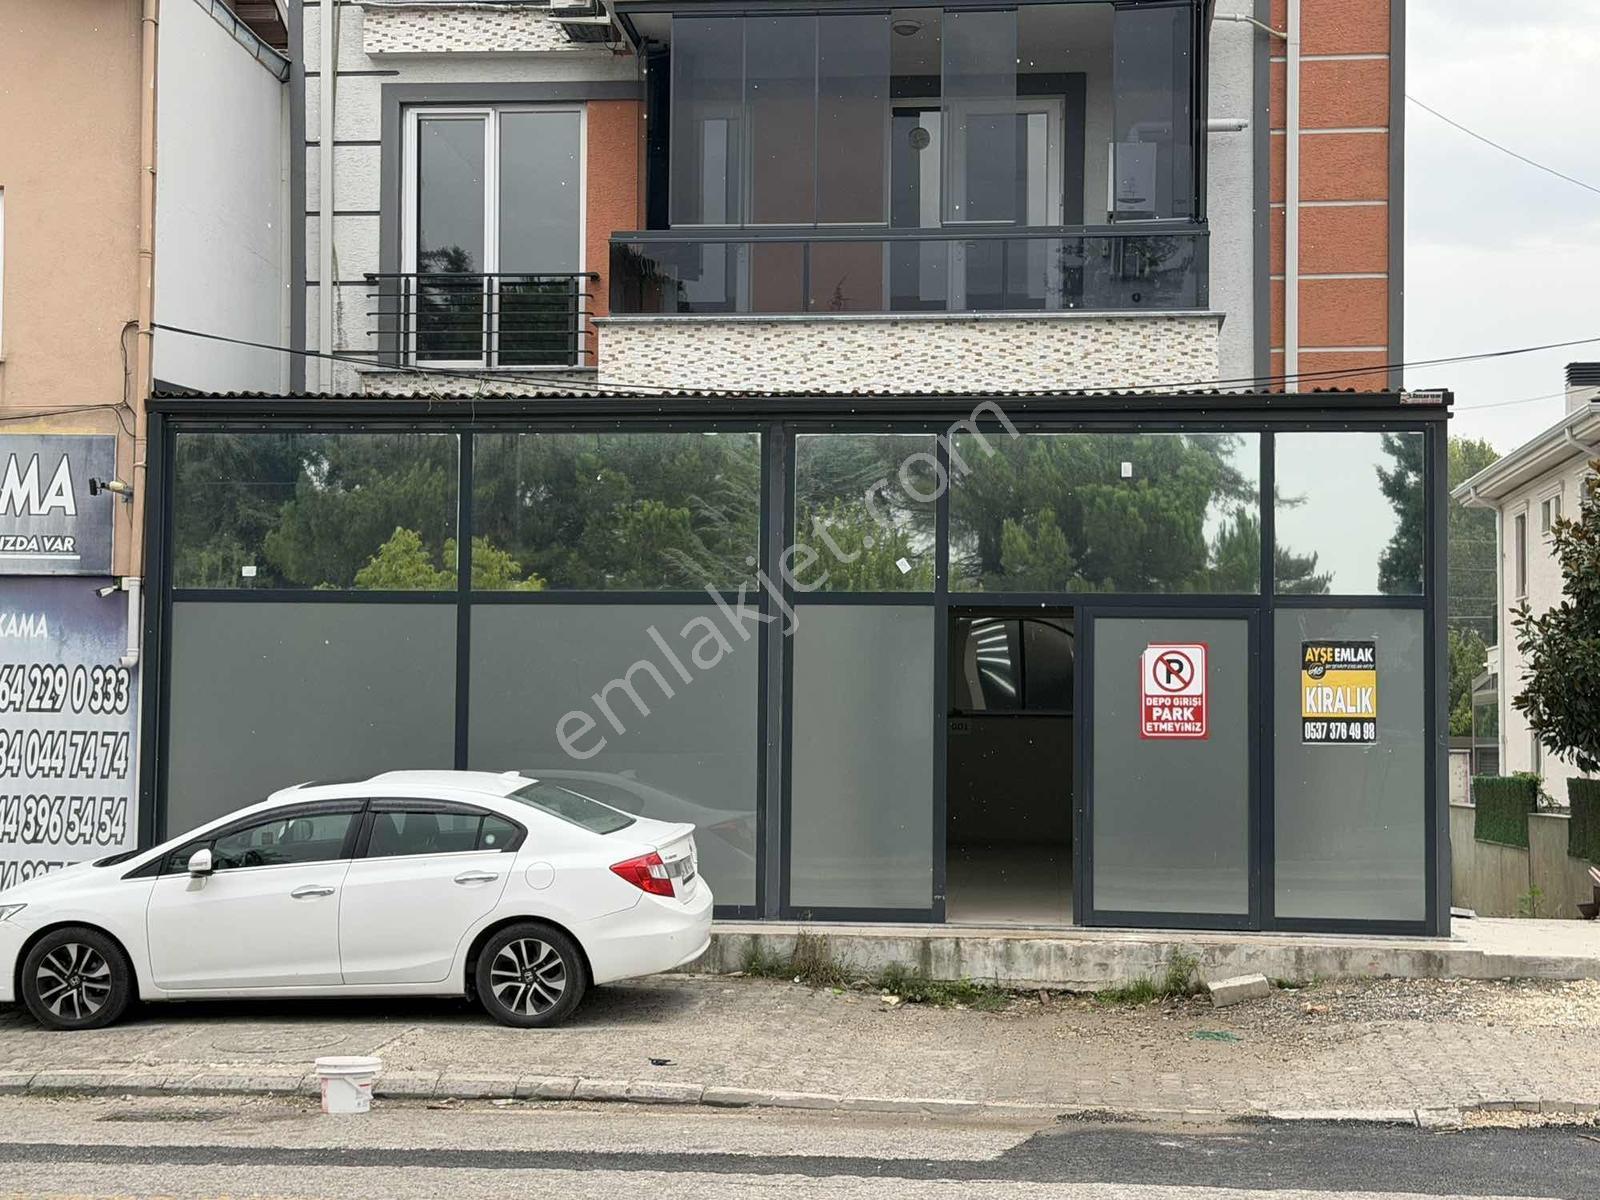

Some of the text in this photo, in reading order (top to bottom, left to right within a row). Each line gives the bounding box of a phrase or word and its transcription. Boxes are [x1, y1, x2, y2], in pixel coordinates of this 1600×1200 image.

[41, 535, 76, 552] VAR
[1305, 647, 1374, 663] AYŞE EMLAK
[26, 663, 69, 712] 229
[71, 664, 87, 714] 0
[89, 664, 130, 714] 333
[1146, 697, 1171, 706] DEPO
[1152, 707, 1195, 721] PARK
[1146, 722, 1202, 732] ETMEYİNİZ
[1304, 721, 1327, 740] 0537
[25, 728, 67, 779] 044
[69, 730, 99, 779] 74
[100, 731, 130, 779] 74
[21, 794, 66, 845] 396
[65, 796, 96, 845] 54
[96, 797, 128, 846] 54
